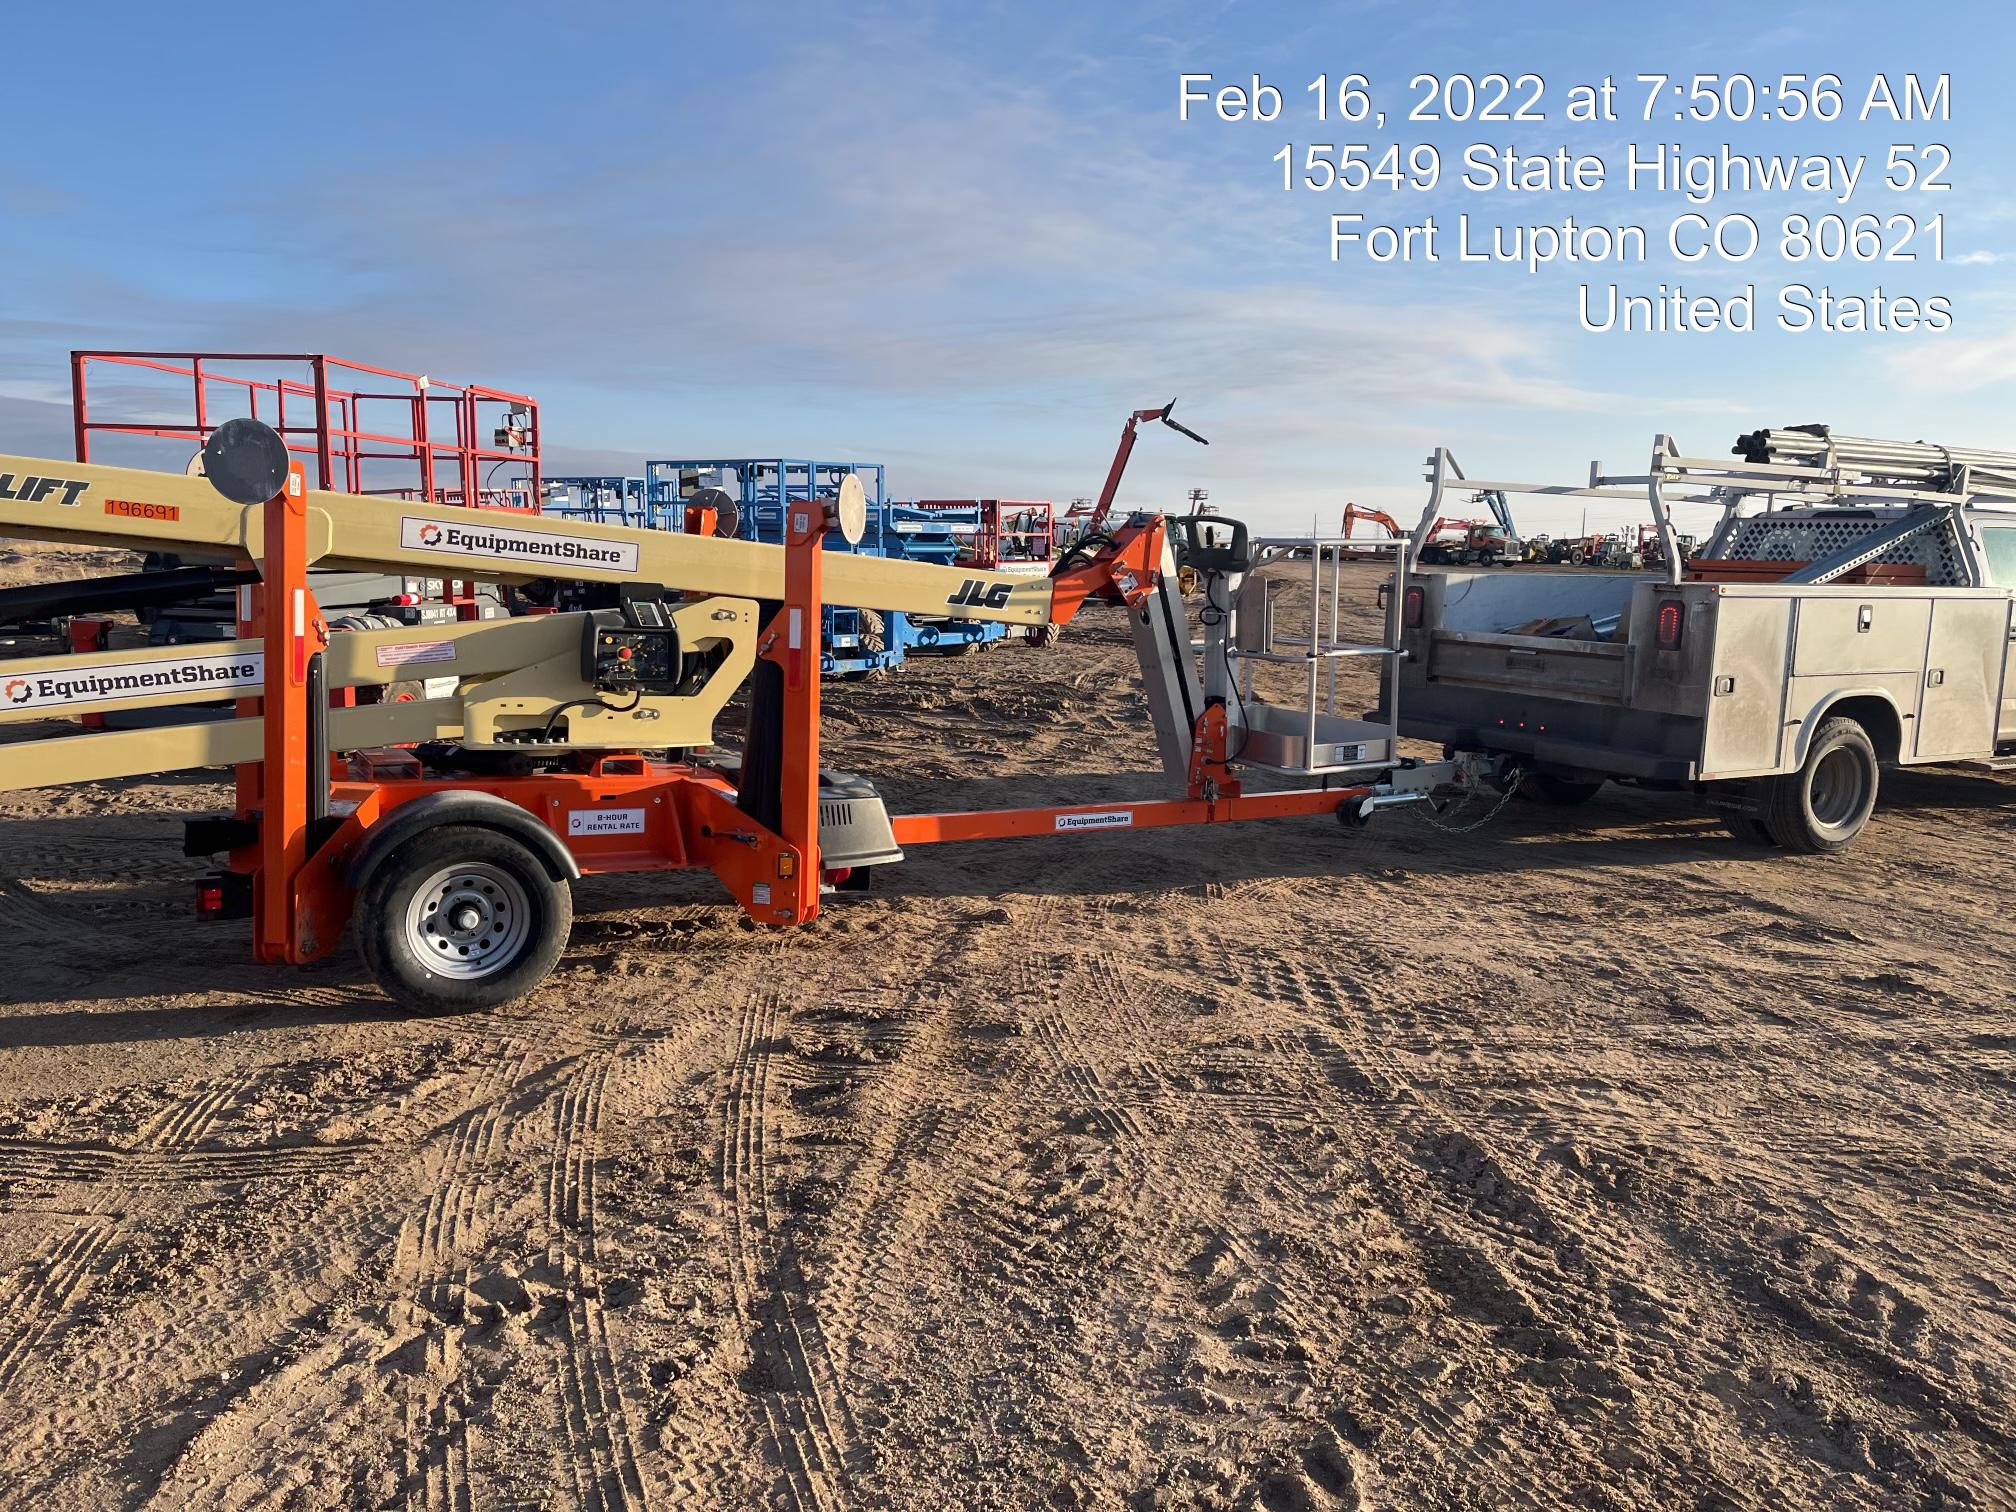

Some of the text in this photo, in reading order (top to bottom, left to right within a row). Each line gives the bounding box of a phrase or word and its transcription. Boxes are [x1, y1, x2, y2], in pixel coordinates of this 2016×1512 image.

[107, 500, 178, 521] 196691
[446, 529, 621, 563] EquipmentShare
[426, 579, 464, 591] SKYCK
[946, 578, 1014, 610] JLG
[37, 662, 256, 699] EquipmentShare
[587, 823, 617, 831] RENTAL
[1067, 816, 1129, 826] EquipmentShare
